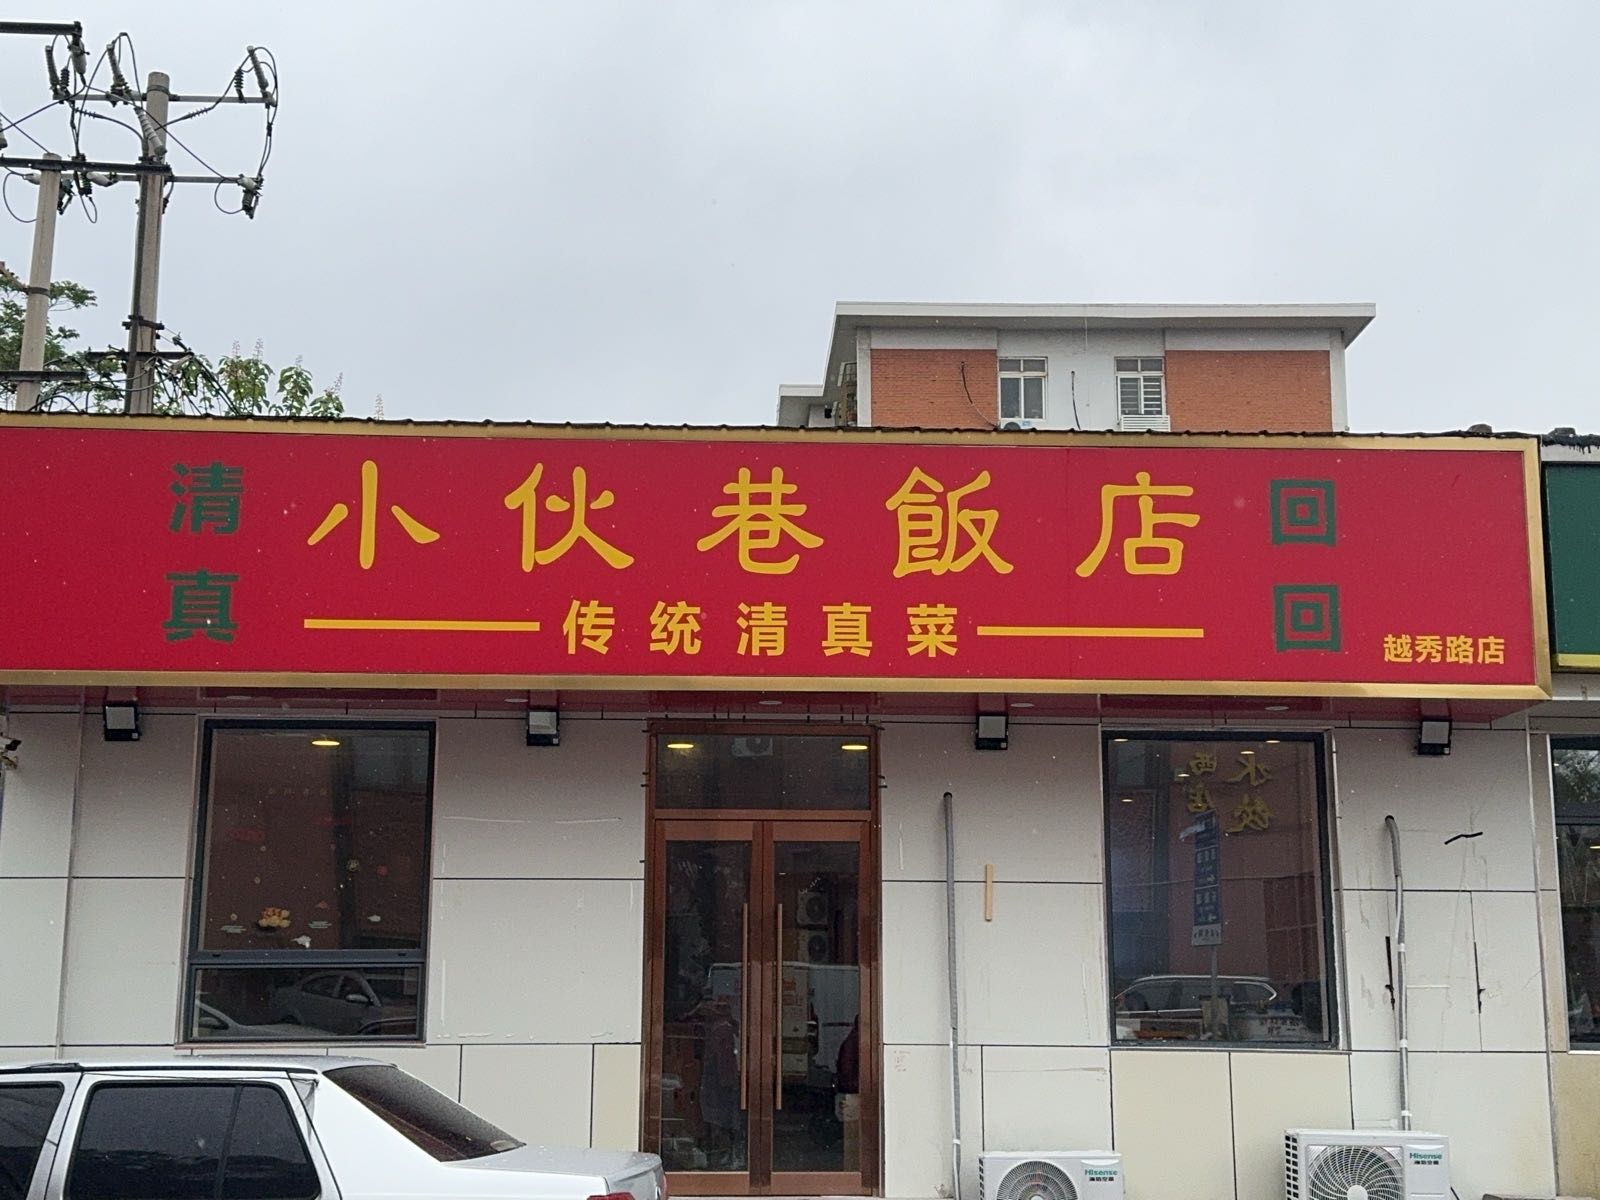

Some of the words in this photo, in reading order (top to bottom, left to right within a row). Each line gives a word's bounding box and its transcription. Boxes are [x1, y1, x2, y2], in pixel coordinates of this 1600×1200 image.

[307, 460, 1201, 578] 小伙巷飯店
[163, 463, 245, 643] 清真
[562, 600, 959, 658] 传统清真菜
[1383, 634, 1506, 665] 越秀路店
[1084, 1168, 1118, 1176] Hisense
[1409, 1152, 1442, 1160] Hisense
